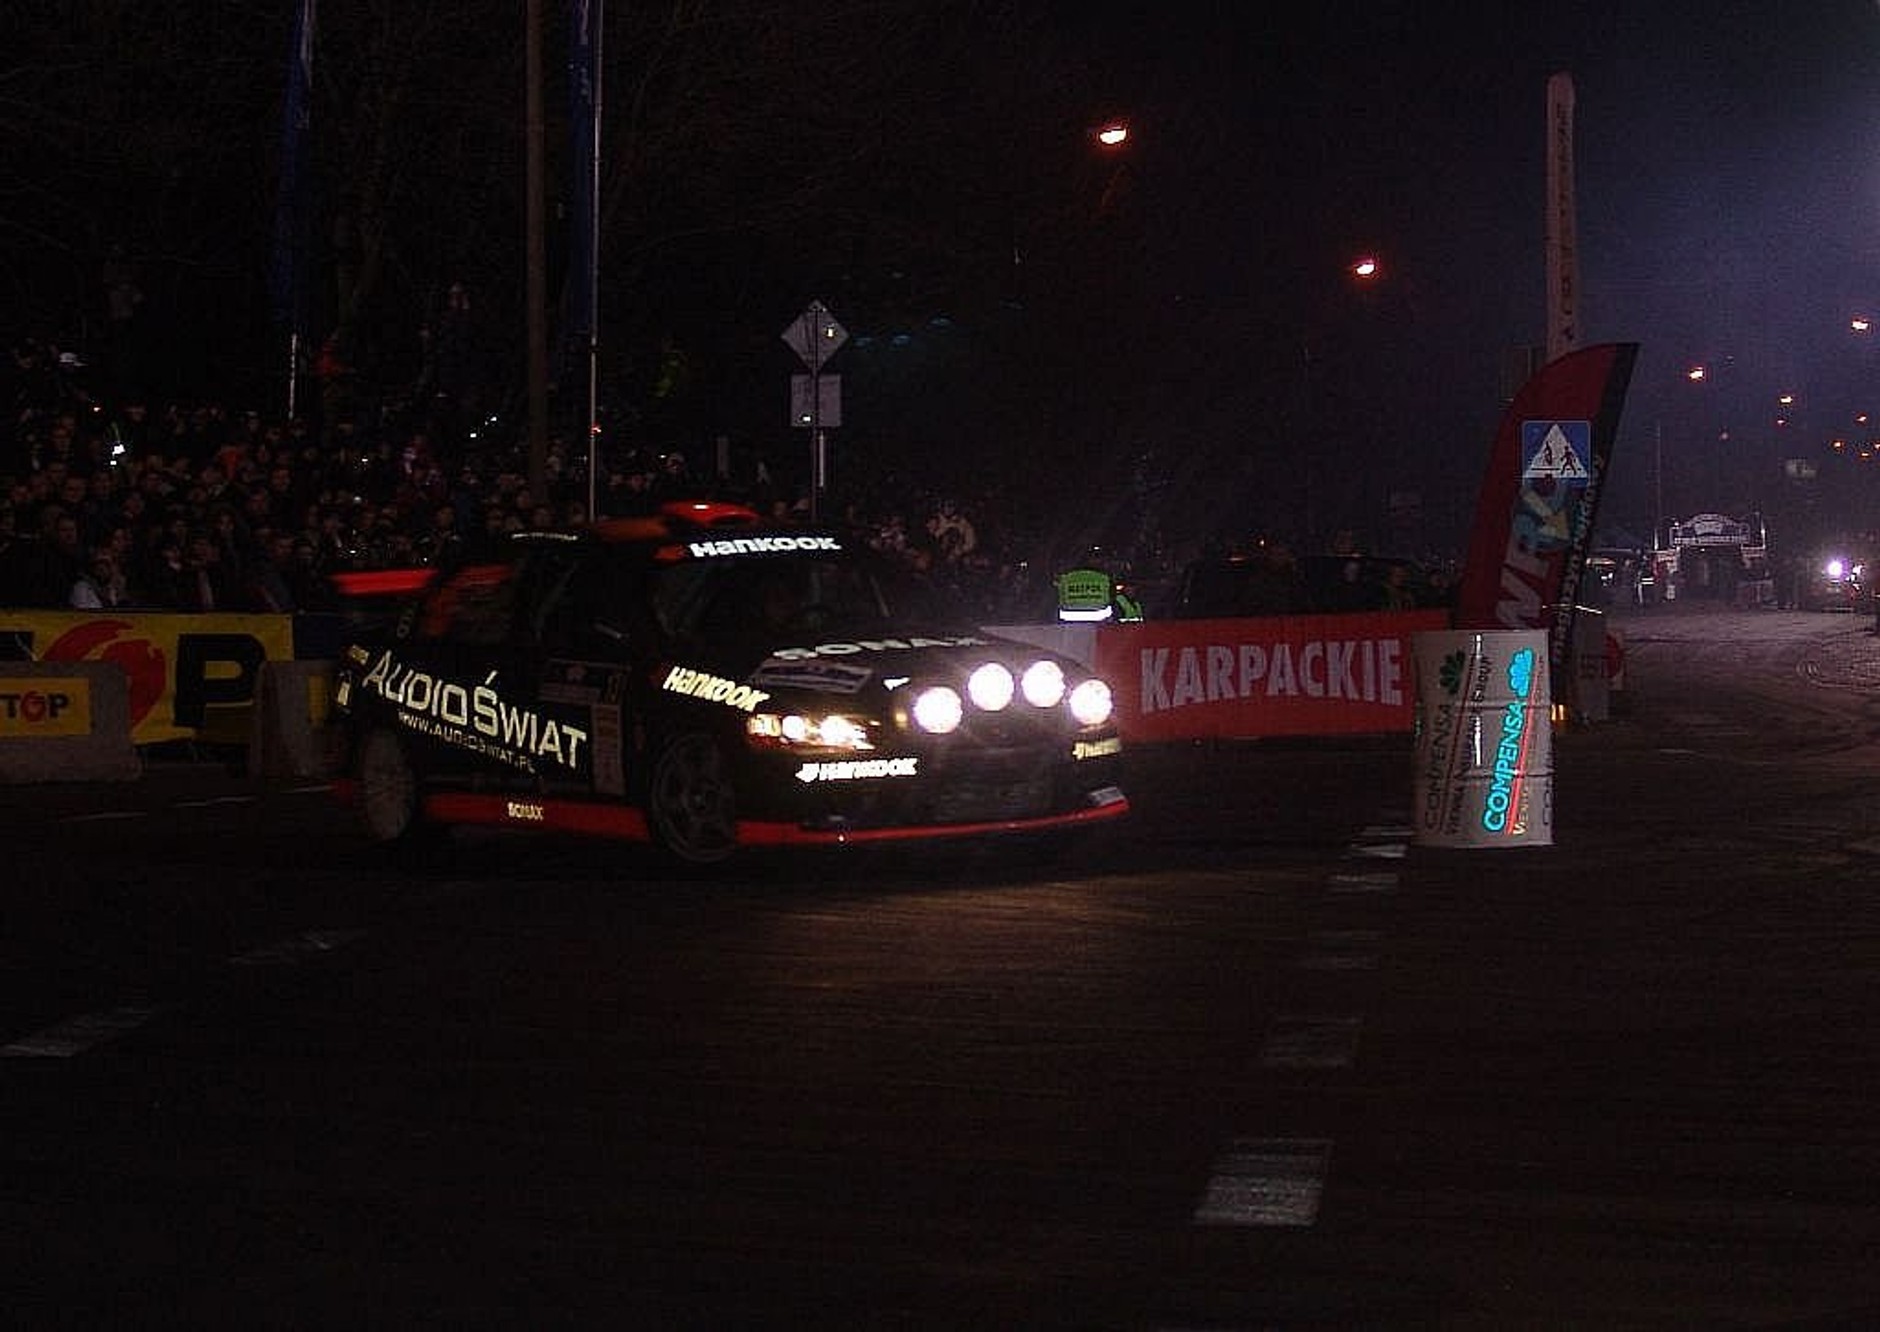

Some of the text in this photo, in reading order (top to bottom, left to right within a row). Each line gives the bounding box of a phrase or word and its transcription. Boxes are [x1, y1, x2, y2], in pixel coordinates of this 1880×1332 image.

[1141, 639, 1402, 713] KARPACKIE
[1424, 704, 1452, 831] COMPENSA
[1482, 700, 1527, 832] COMPENSA
